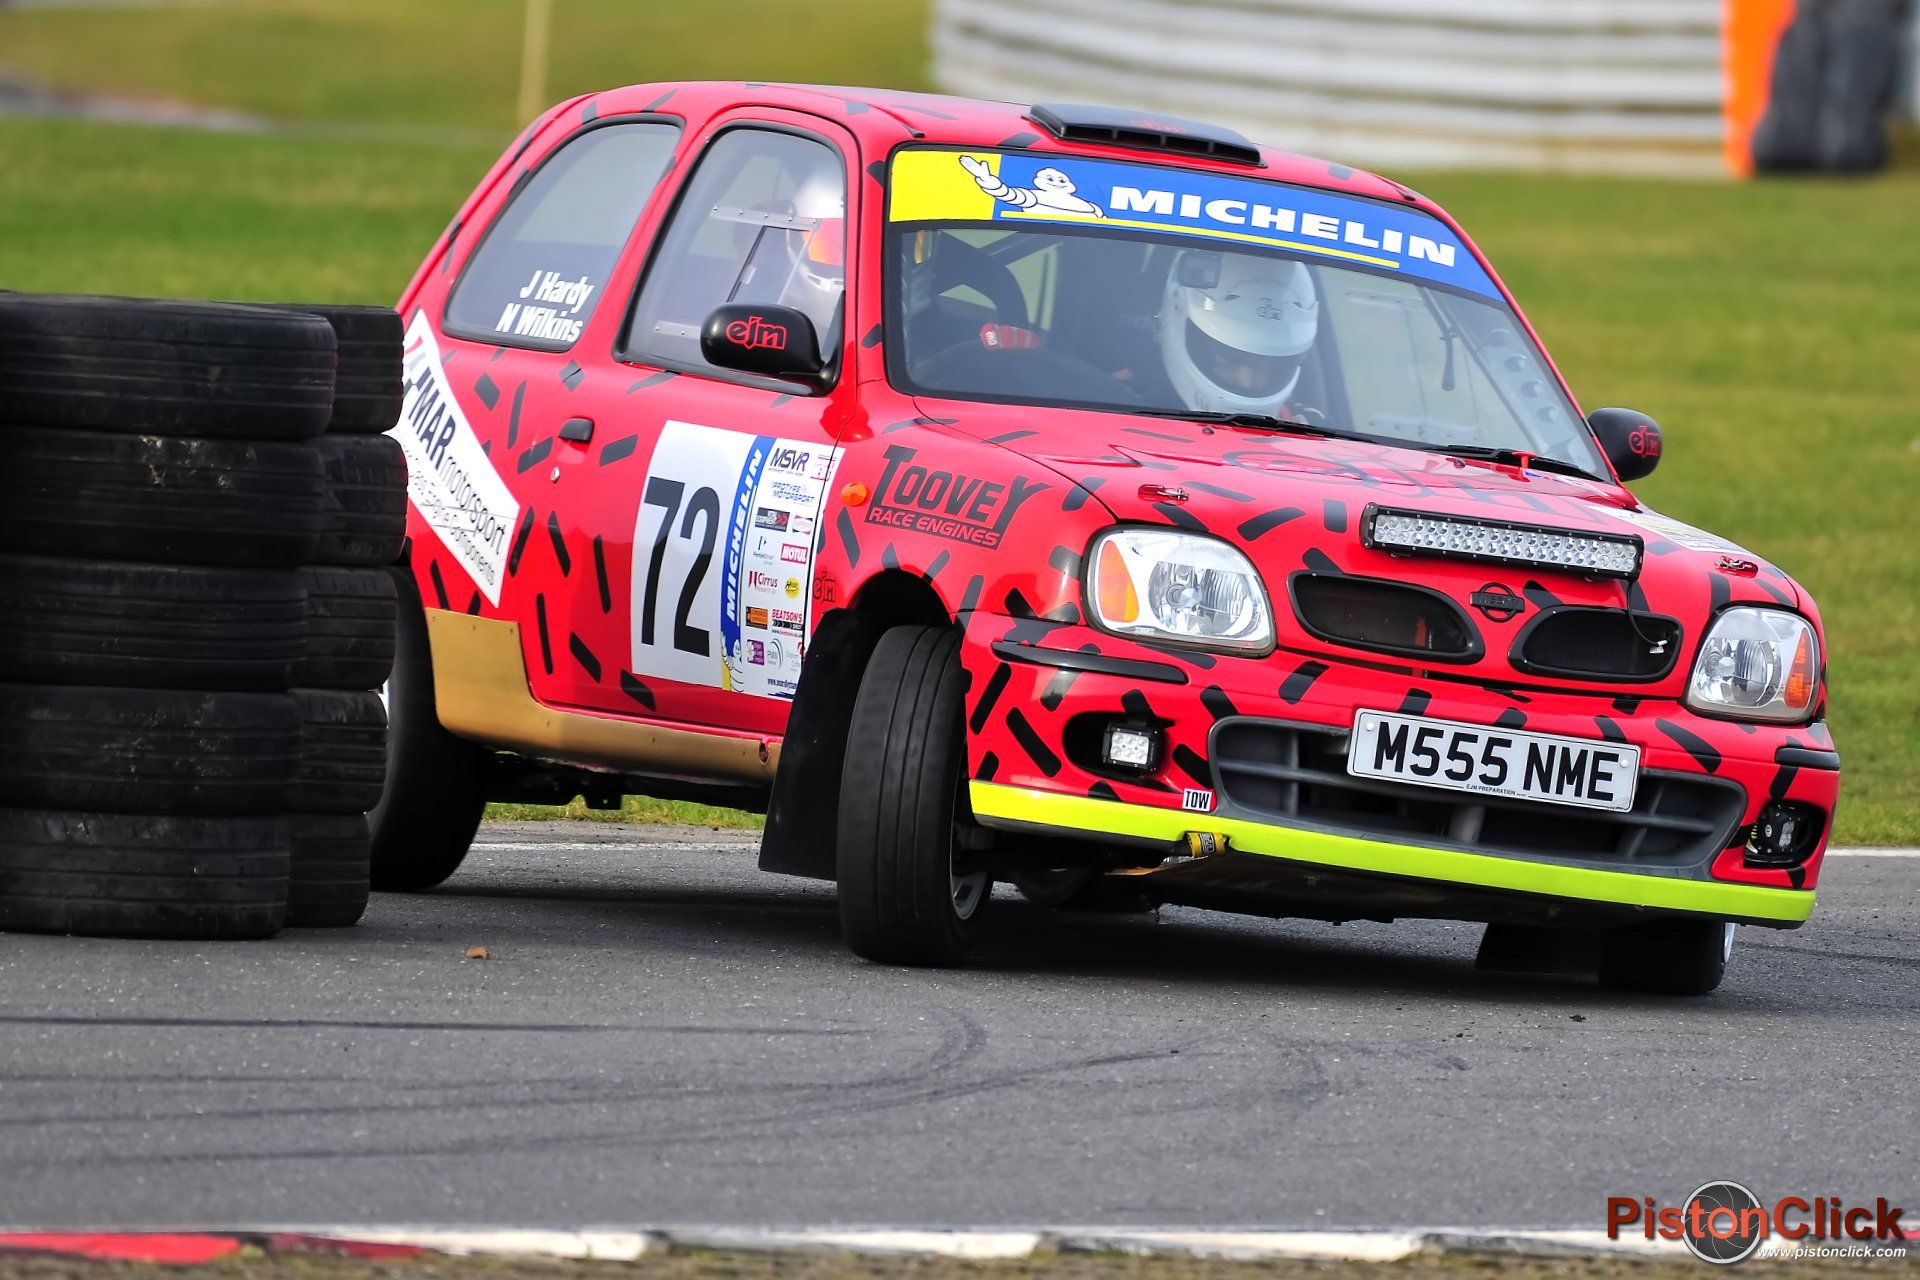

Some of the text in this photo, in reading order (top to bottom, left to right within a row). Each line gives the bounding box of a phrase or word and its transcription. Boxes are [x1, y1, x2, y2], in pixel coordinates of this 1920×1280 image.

[1110, 185, 1456, 268] MICHELIN
[519, 269, 595, 314] J Hardy
[495, 302, 584, 343] N Wilkins
[769, 447, 810, 471] MSVR
[726, 448, 763, 621] MICHELIN
[869, 506, 1000, 546] RACE ENGINES
[641, 475, 721, 658] 72
[781, 545, 807, 562] MOTUL
[758, 572, 778, 587] Cirrus
[772, 609, 803, 623] BEATSON'S
[1373, 721, 1620, 802] M555 NME
[1185, 790, 1210, 810] TOW
[1478, 785, 1516, 796] PREPARATION
